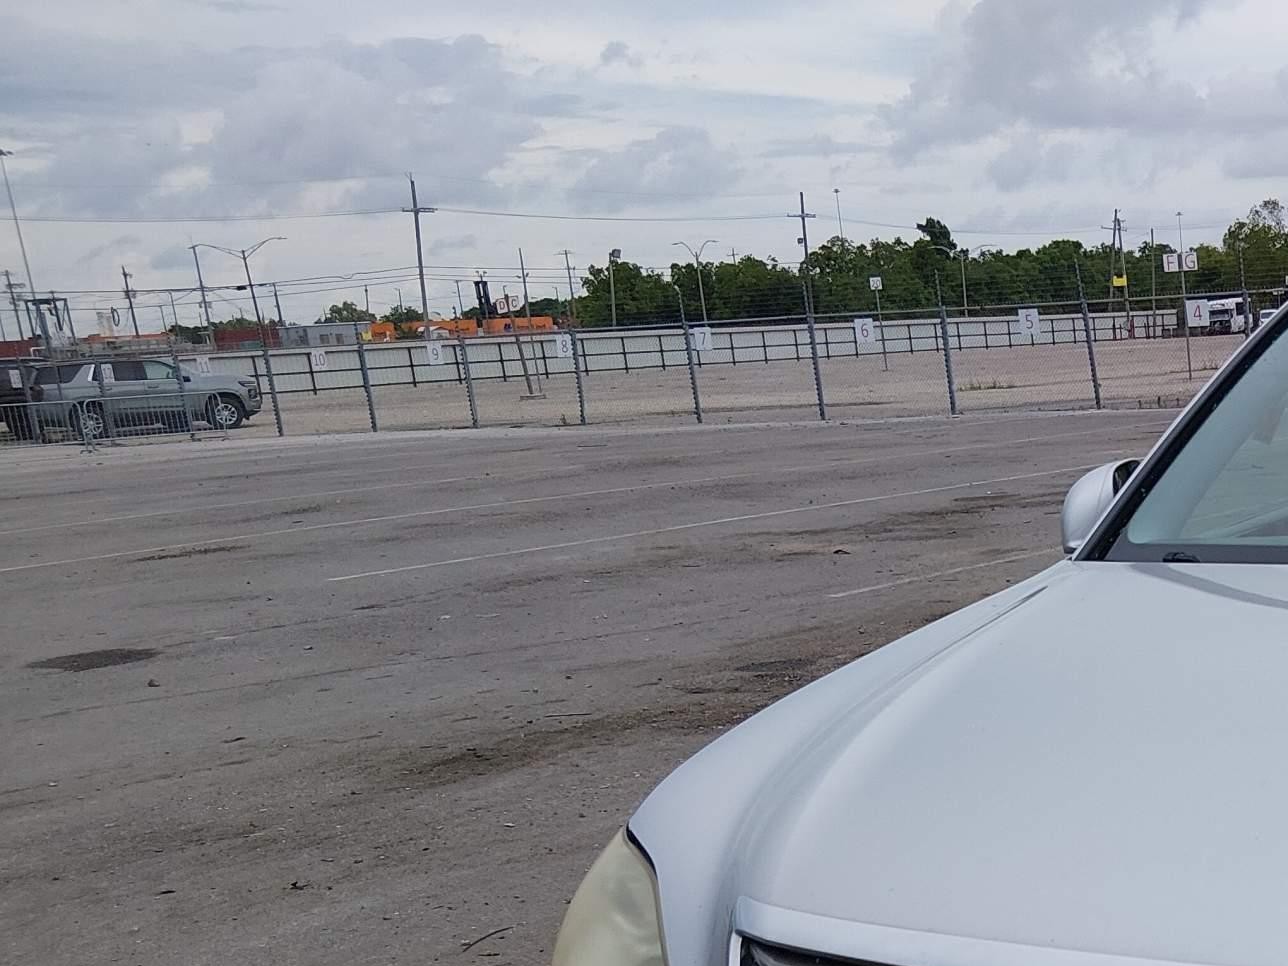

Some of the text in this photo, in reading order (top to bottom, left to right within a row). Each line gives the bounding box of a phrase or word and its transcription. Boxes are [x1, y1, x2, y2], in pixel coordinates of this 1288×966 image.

[1166, 254, 1176, 271] F
[1184, 253, 1196, 270] G
[498, 300, 506, 310] D
[511, 298, 518, 308] C
[1193, 304, 1202, 321] 4
[1025, 314, 1034, 329] 5
[860, 323, 869, 338] 6
[700, 331, 706, 346] 7
[561, 339, 569, 353] 8
[314, 353, 326, 366] 10
[431, 347, 439, 361] 9
[199, 359, 210, 373] 11
